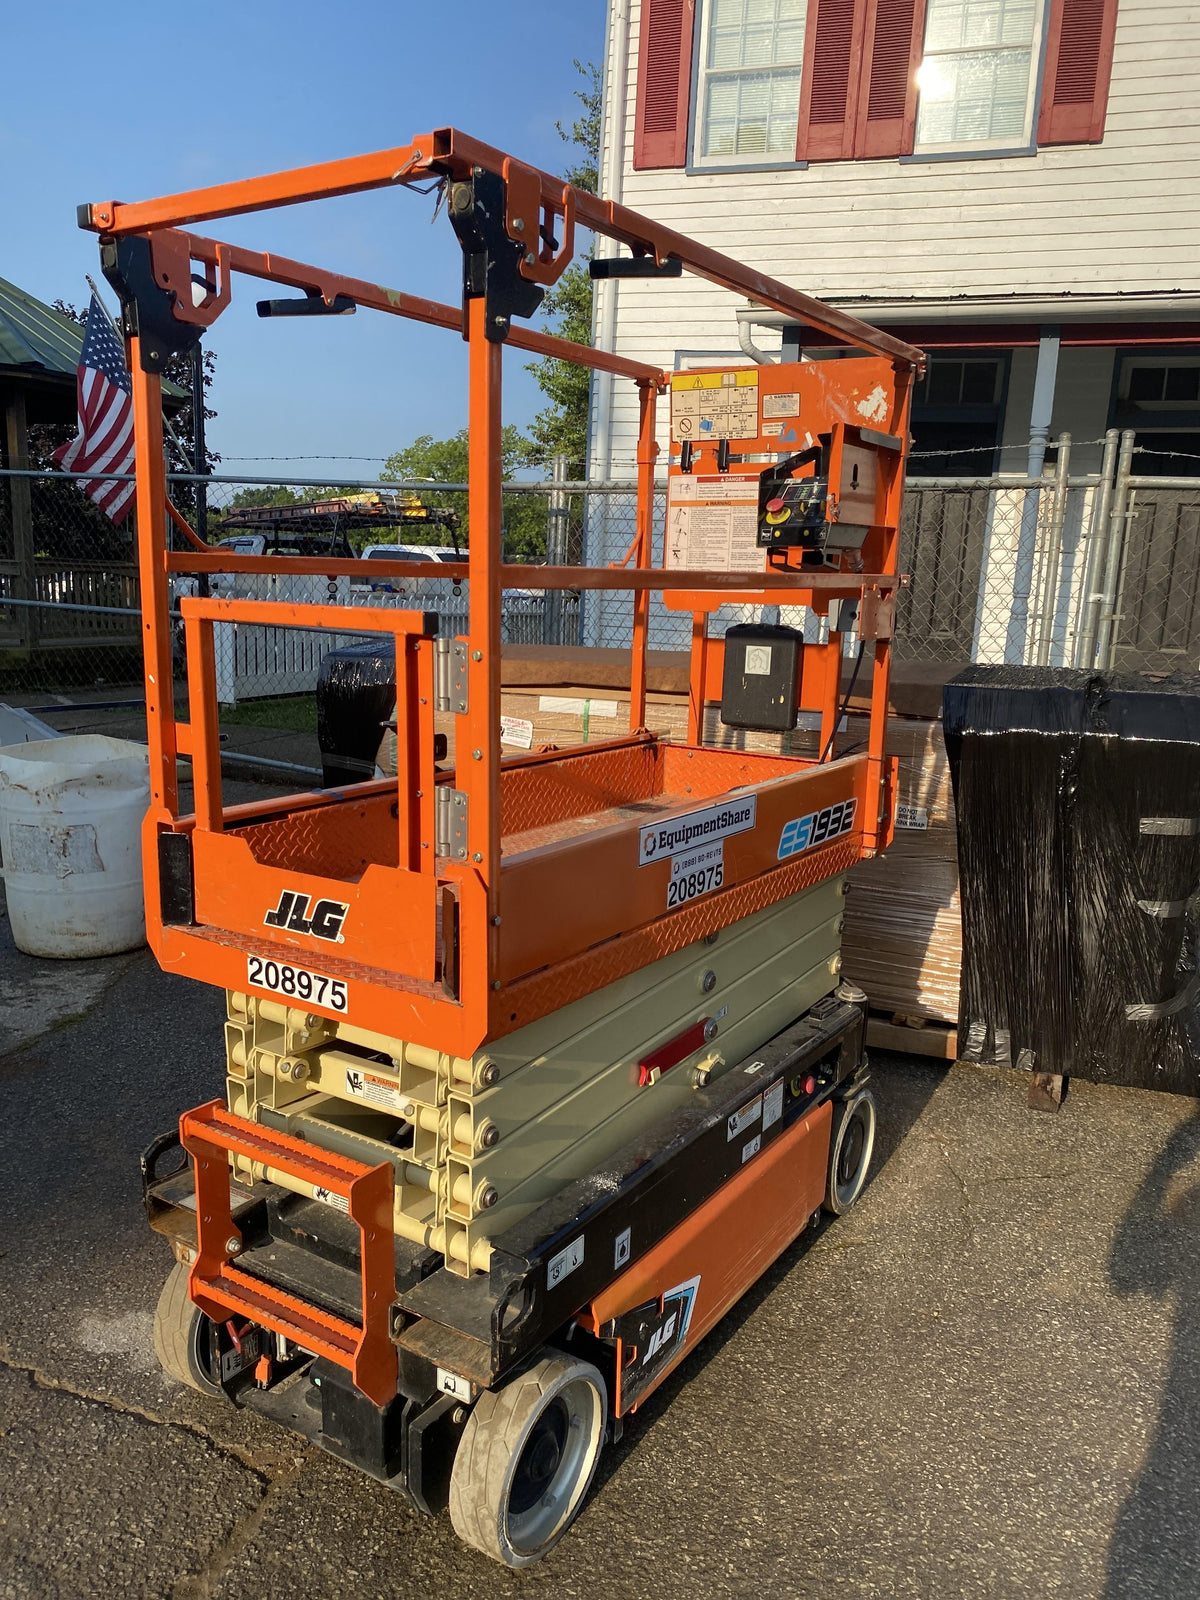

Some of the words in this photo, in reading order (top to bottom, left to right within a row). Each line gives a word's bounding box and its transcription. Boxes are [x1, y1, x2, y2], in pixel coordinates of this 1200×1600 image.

[658, 808, 751, 850] EquipmentShare
[778, 799, 857, 858] ES1932
[898, 806, 906, 814] DO
[668, 863, 723, 907] 208975
[263, 889, 350, 943] JLG
[248, 956, 347, 1010] 208975
[642, 1311, 678, 1366] JLG
